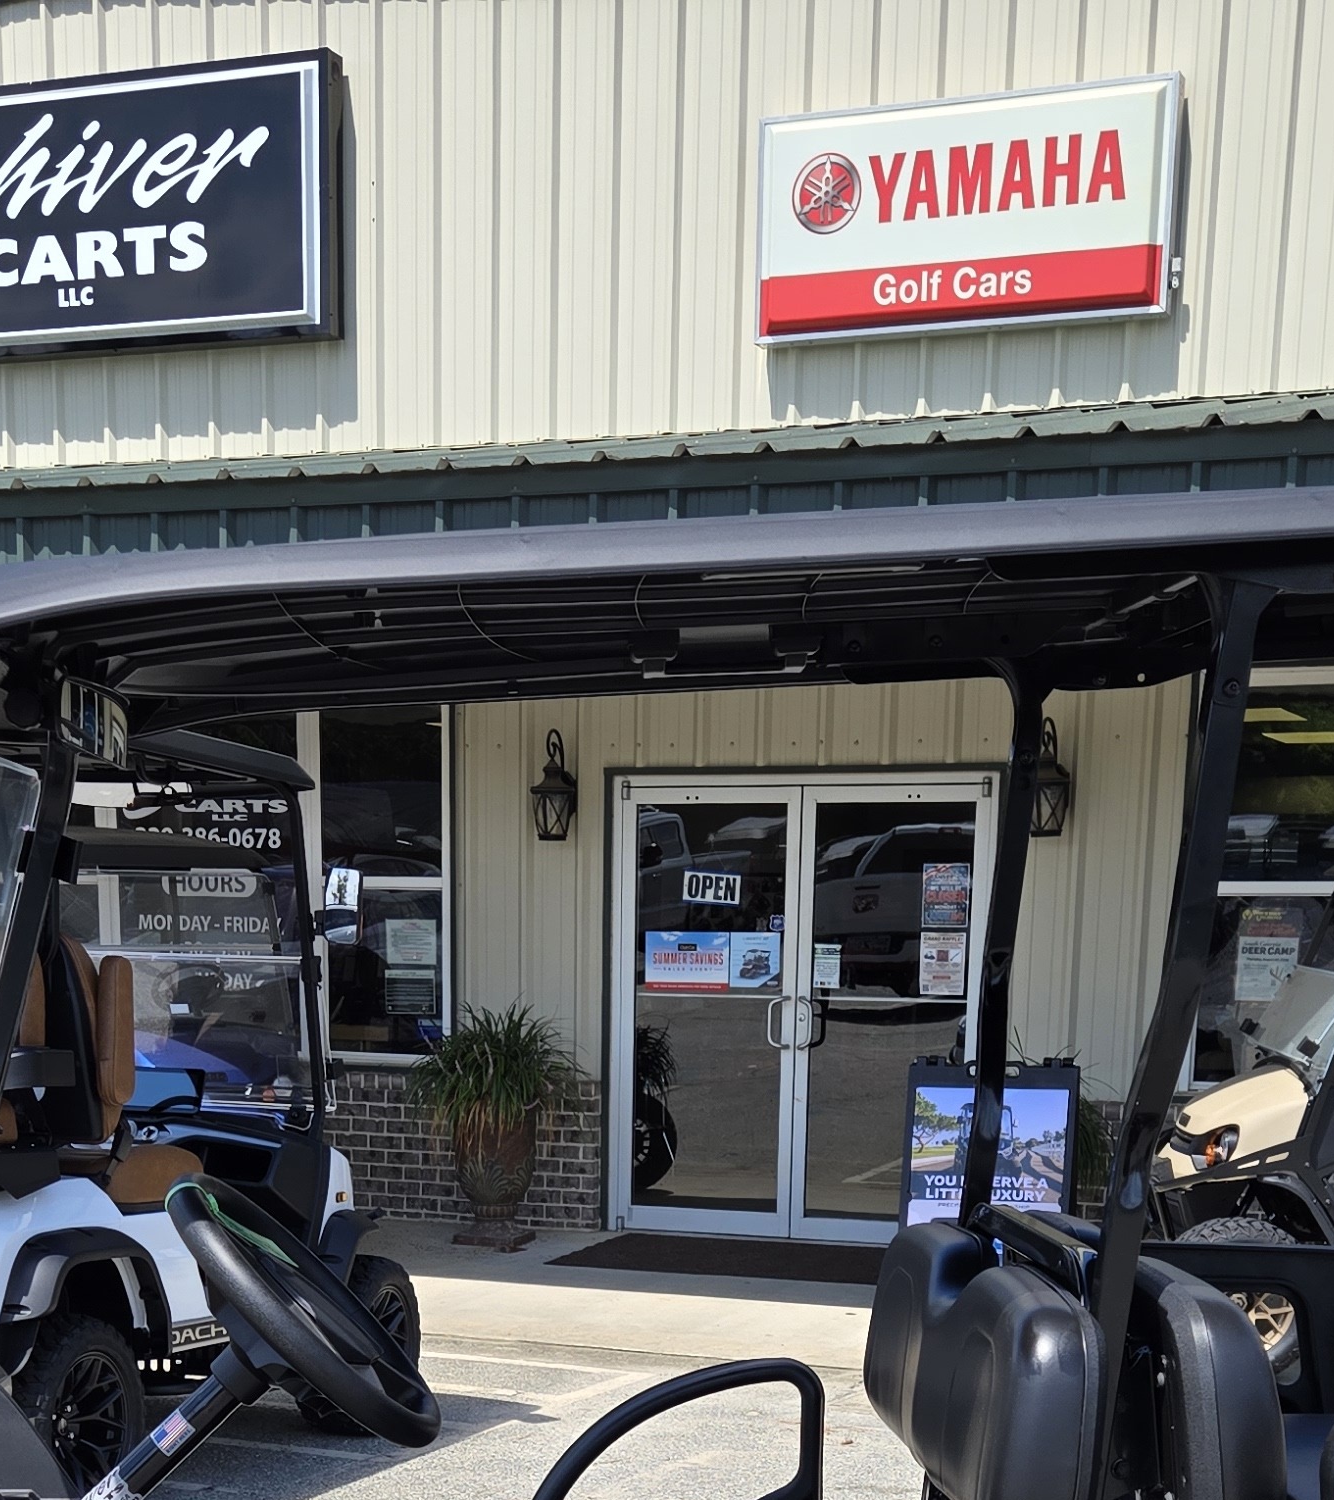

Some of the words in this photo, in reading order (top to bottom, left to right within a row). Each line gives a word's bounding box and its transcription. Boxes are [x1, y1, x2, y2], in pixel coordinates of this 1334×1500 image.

[868, 129, 1126, 223] YAMAHA
[873, 269, 942, 306] Golf
[952, 267, 1032, 299] Cars
[57, 287, 94, 308] LLC
[211, 814, 248, 822] LLC
[135, 827, 282, 849] 86-0678
[687, 874, 736, 901] OPEN
[653, 952, 687, 965] SUMMER
[690, 953, 724, 966] SAVINGS
[1242, 946, 1266, 955] DEER
[1268, 947, 1296, 955] CAMP
[924, 1175, 957, 1187] YOU
[1038, 1178, 1049, 1189] A
[925, 1188, 962, 1199] LITT
[991, 1189, 1046, 1202] UXURY
[171, 1323, 228, 1345] OACH
